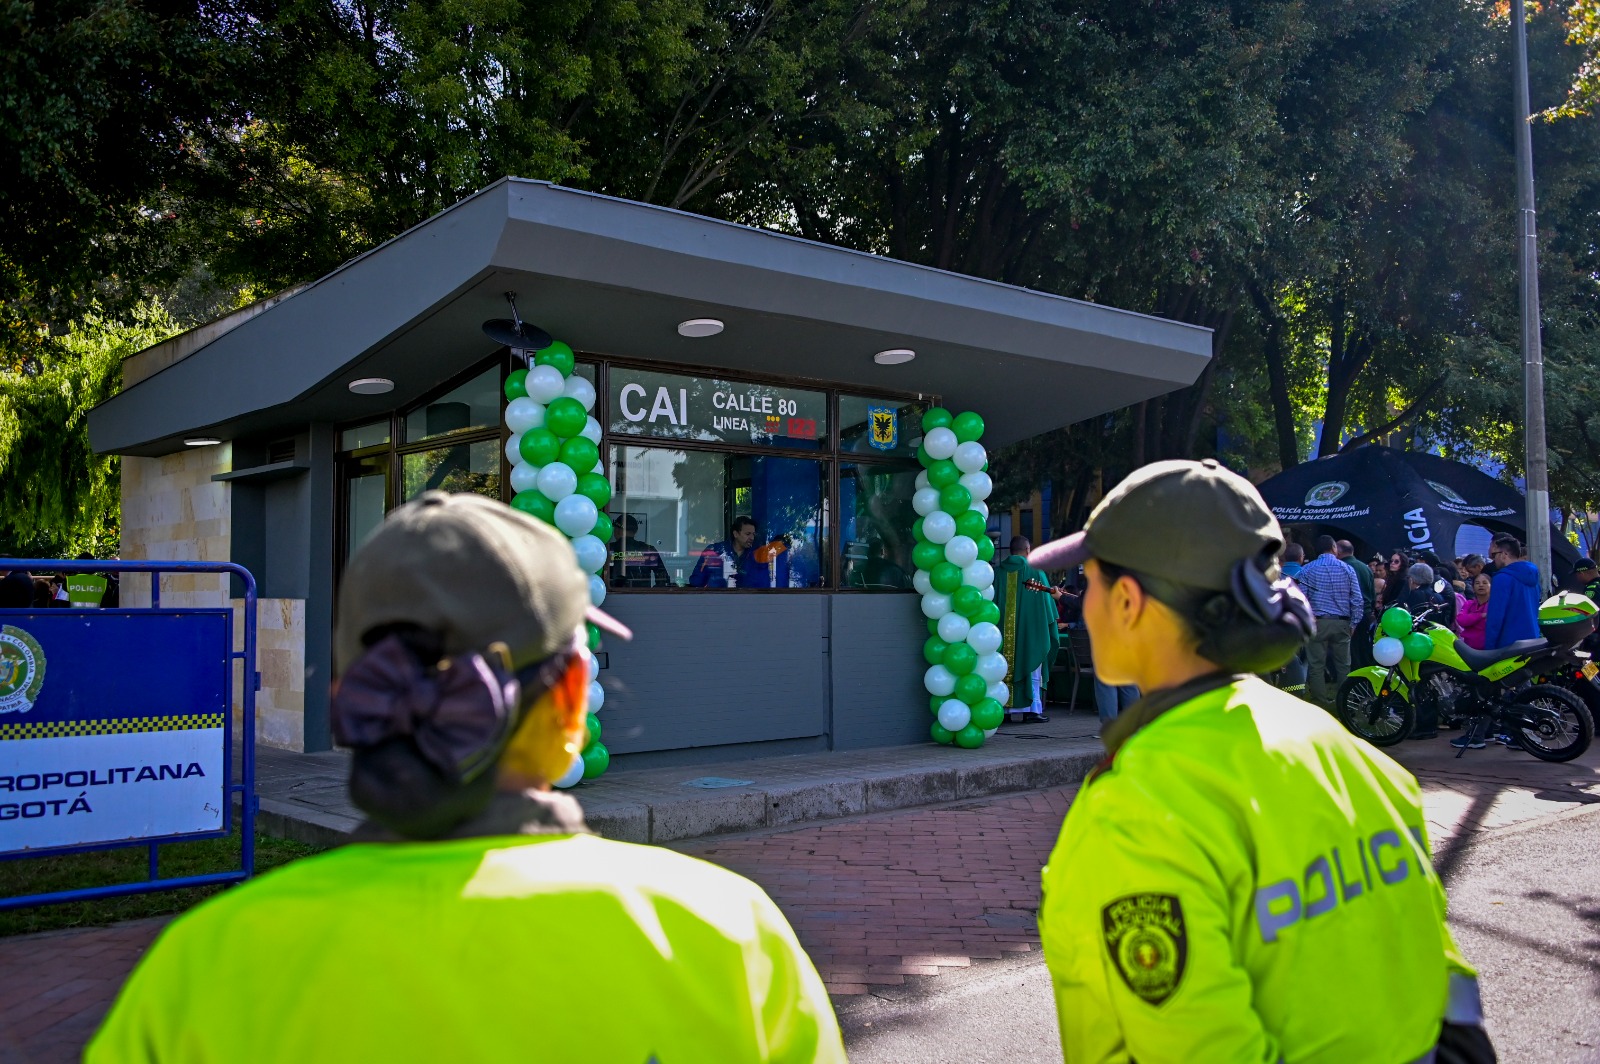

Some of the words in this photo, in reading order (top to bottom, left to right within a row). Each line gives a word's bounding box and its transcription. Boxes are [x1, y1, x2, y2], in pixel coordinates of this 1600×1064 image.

[619, 383, 688, 427] CAI
[712, 391, 773, 415] CALLE
[778, 398, 797, 417] 80
[713, 415, 749, 432] LINEA
[787, 417, 816, 437] 123
[1271, 506, 1301, 515] POLICÍA
[1299, 513, 1330, 521] POLICÍA
[1403, 507, 1435, 553] ICÍA
[0, 790, 93, 820] GOTÁ
